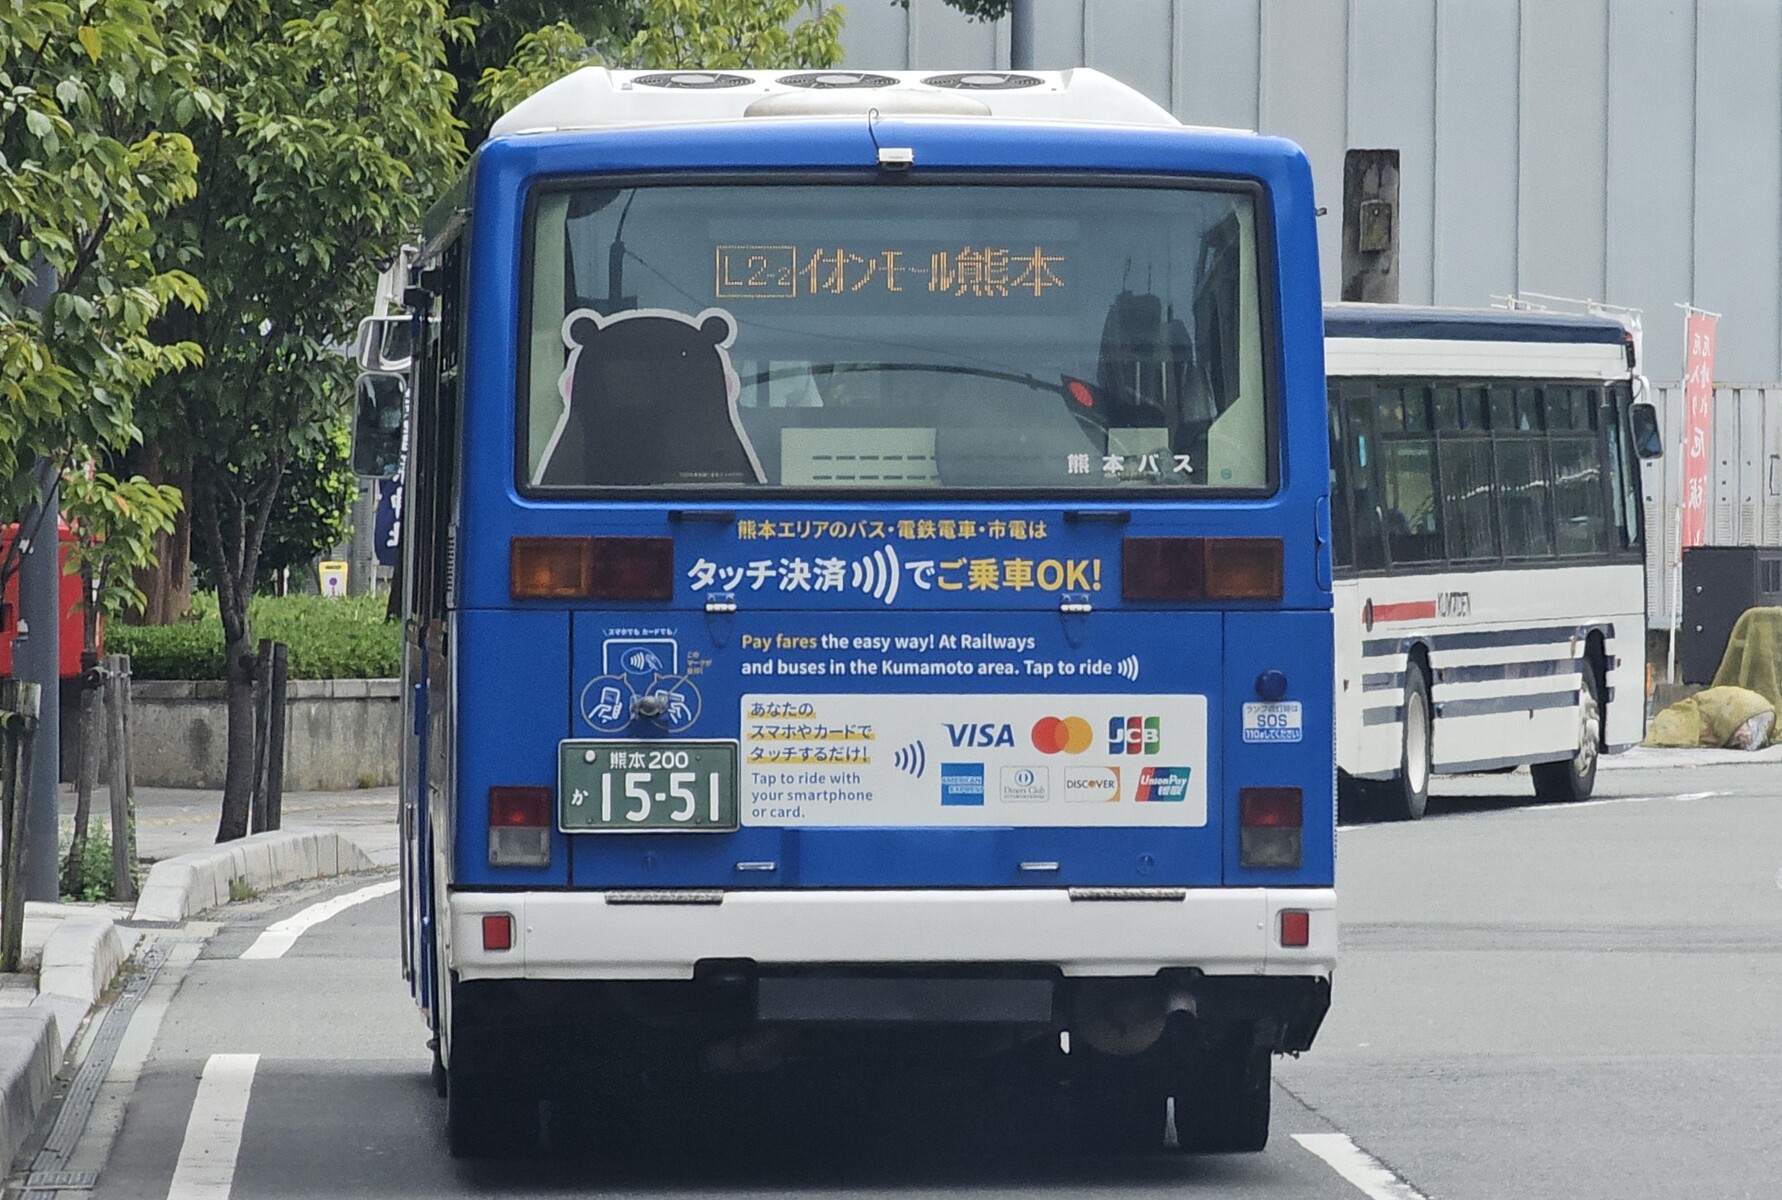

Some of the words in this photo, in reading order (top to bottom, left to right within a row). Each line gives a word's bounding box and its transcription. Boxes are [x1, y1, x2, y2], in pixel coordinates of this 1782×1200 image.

[799, 246, 1065, 297] イオンモール熊本
[1066, 453, 1193, 474] 熊本バス
[737, 519, 1047, 540] 熊本エリアのバス・電鉄電車・市電は
[687, 557, 847, 592] タッチ決済
[904, 557, 1101, 592] でご乗車OK!
[741, 634, 772, 652] Pay
[776, 633, 817, 649] fares
[820, 634, 849, 649] the
[853, 637, 890, 653] easy
[894, 634, 934, 653] way!
[939, 634, 957, 649] At
[961, 633, 1035, 653] Railways
[741, 659, 773, 675] and
[777, 659, 826, 675] buses
[830, 659, 845, 675] in
[850, 659, 878, 675] the
[882, 660, 974, 675] Kumamoto
[978, 662, 1020, 675] area.
[1023, 660, 1054, 679] Tap
[1057, 661, 1075, 675] to
[1079, 659, 1113, 675] ride
[750, 702, 814, 717] あなたの
[1257, 714, 1288, 727] SOS
[750, 724, 872, 739] スマホやカードで
[941, 724, 1015, 748] VISA
[610, 751, 689, 769] 熊本200
[750, 746, 868, 762] タッチするだけ!
[751, 772, 777, 787] Tap
[780, 773, 795, 784] to
[798, 772, 826, 784] ride
[830, 772, 861, 784] with
[1066, 780, 1116, 789] DISCOVER
[1140, 774, 1188, 787] UnionPay
[571, 788, 589, 806] か
[602, 772, 719, 822] 15-51
[751, 791, 784, 804] your
[787, 789, 873, 803] smartphone
[751, 808, 767, 818] or
[769, 806, 805, 818] card.
